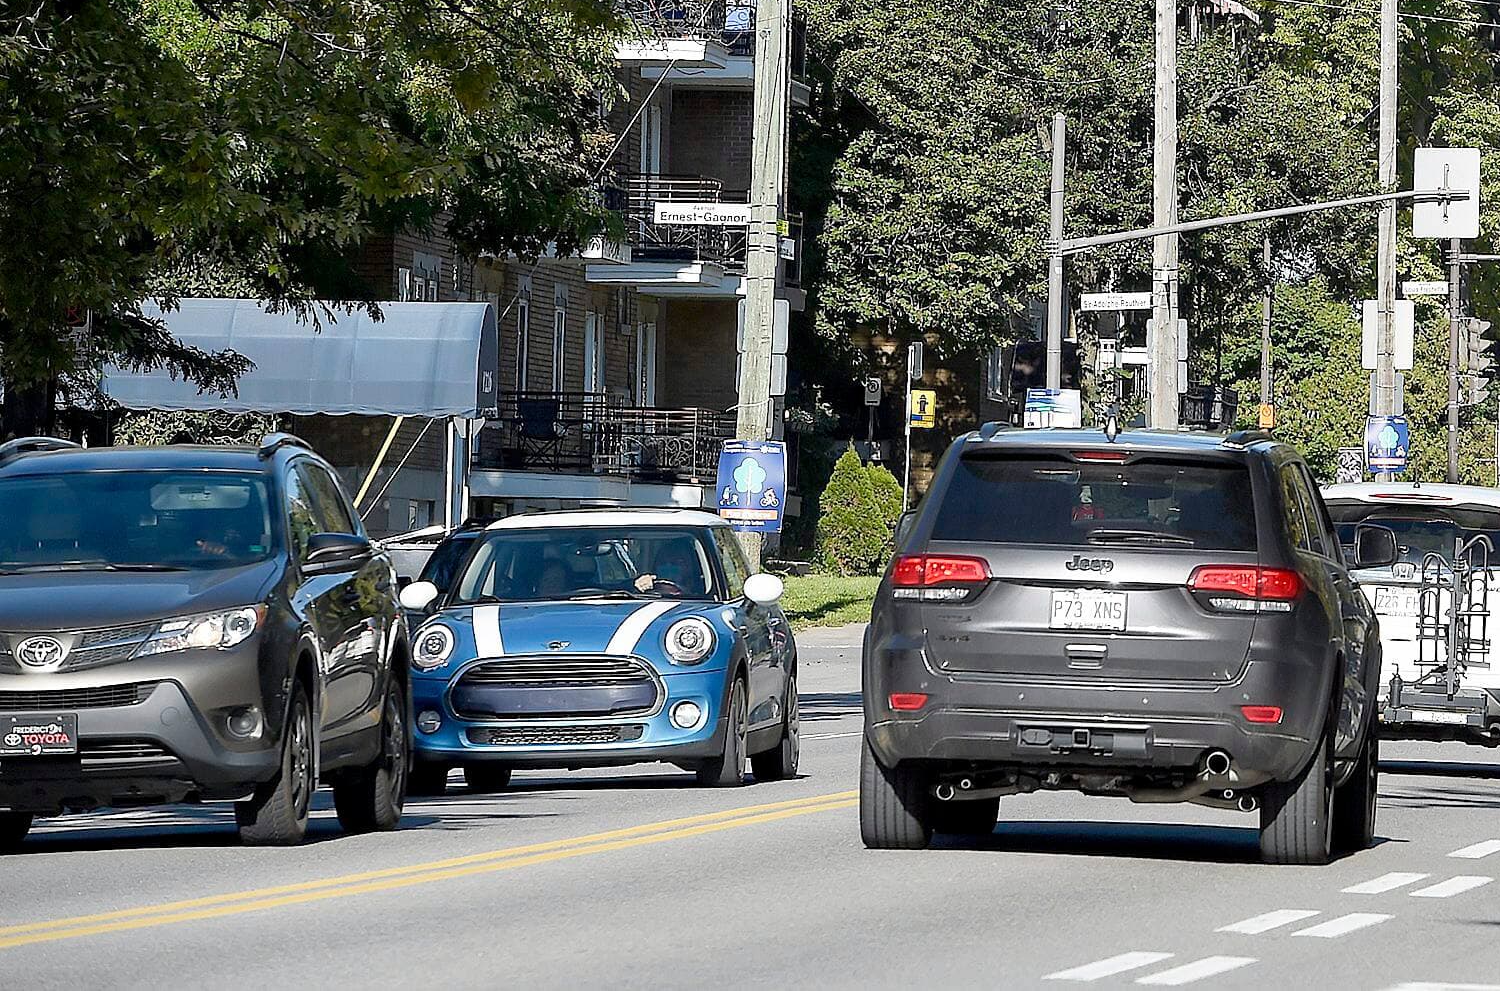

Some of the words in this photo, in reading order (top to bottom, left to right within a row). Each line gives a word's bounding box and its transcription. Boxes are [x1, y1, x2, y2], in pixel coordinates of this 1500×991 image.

[1066, 555, 1114, 574] Jeep
[1055, 601, 1082, 618] P73
[1093, 602, 1122, 620] XNS
[21, 733, 70, 746] TOYOTA
